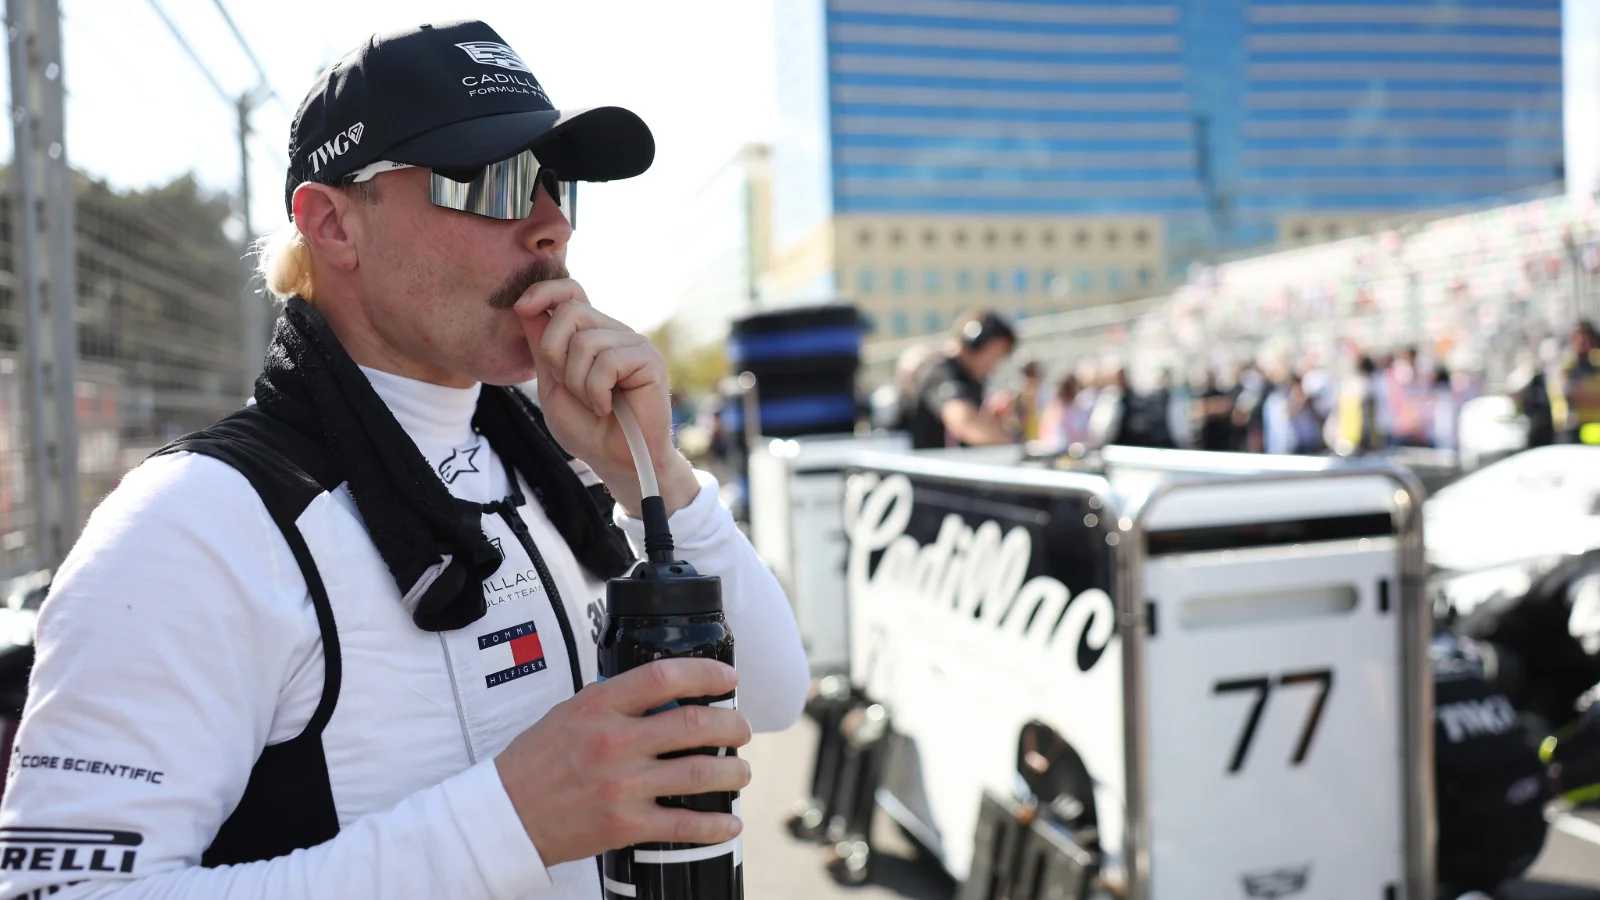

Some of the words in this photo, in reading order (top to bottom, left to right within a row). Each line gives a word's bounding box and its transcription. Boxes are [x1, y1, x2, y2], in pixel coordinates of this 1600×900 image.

[469, 86, 530, 97] FORMULA
[483, 569, 537, 594] ILLAC
[843, 471, 1116, 674] Cadillac
[514, 585, 542, 599] TEAM
[481, 624, 533, 646] TOMMY
[489, 660, 544, 685] HILFIGER
[1212, 668, 1334, 775] 77
[21, 755, 60, 769] CORE
[62, 757, 164, 784] SCIENTIFIC
[0, 847, 137, 873] RELLI
